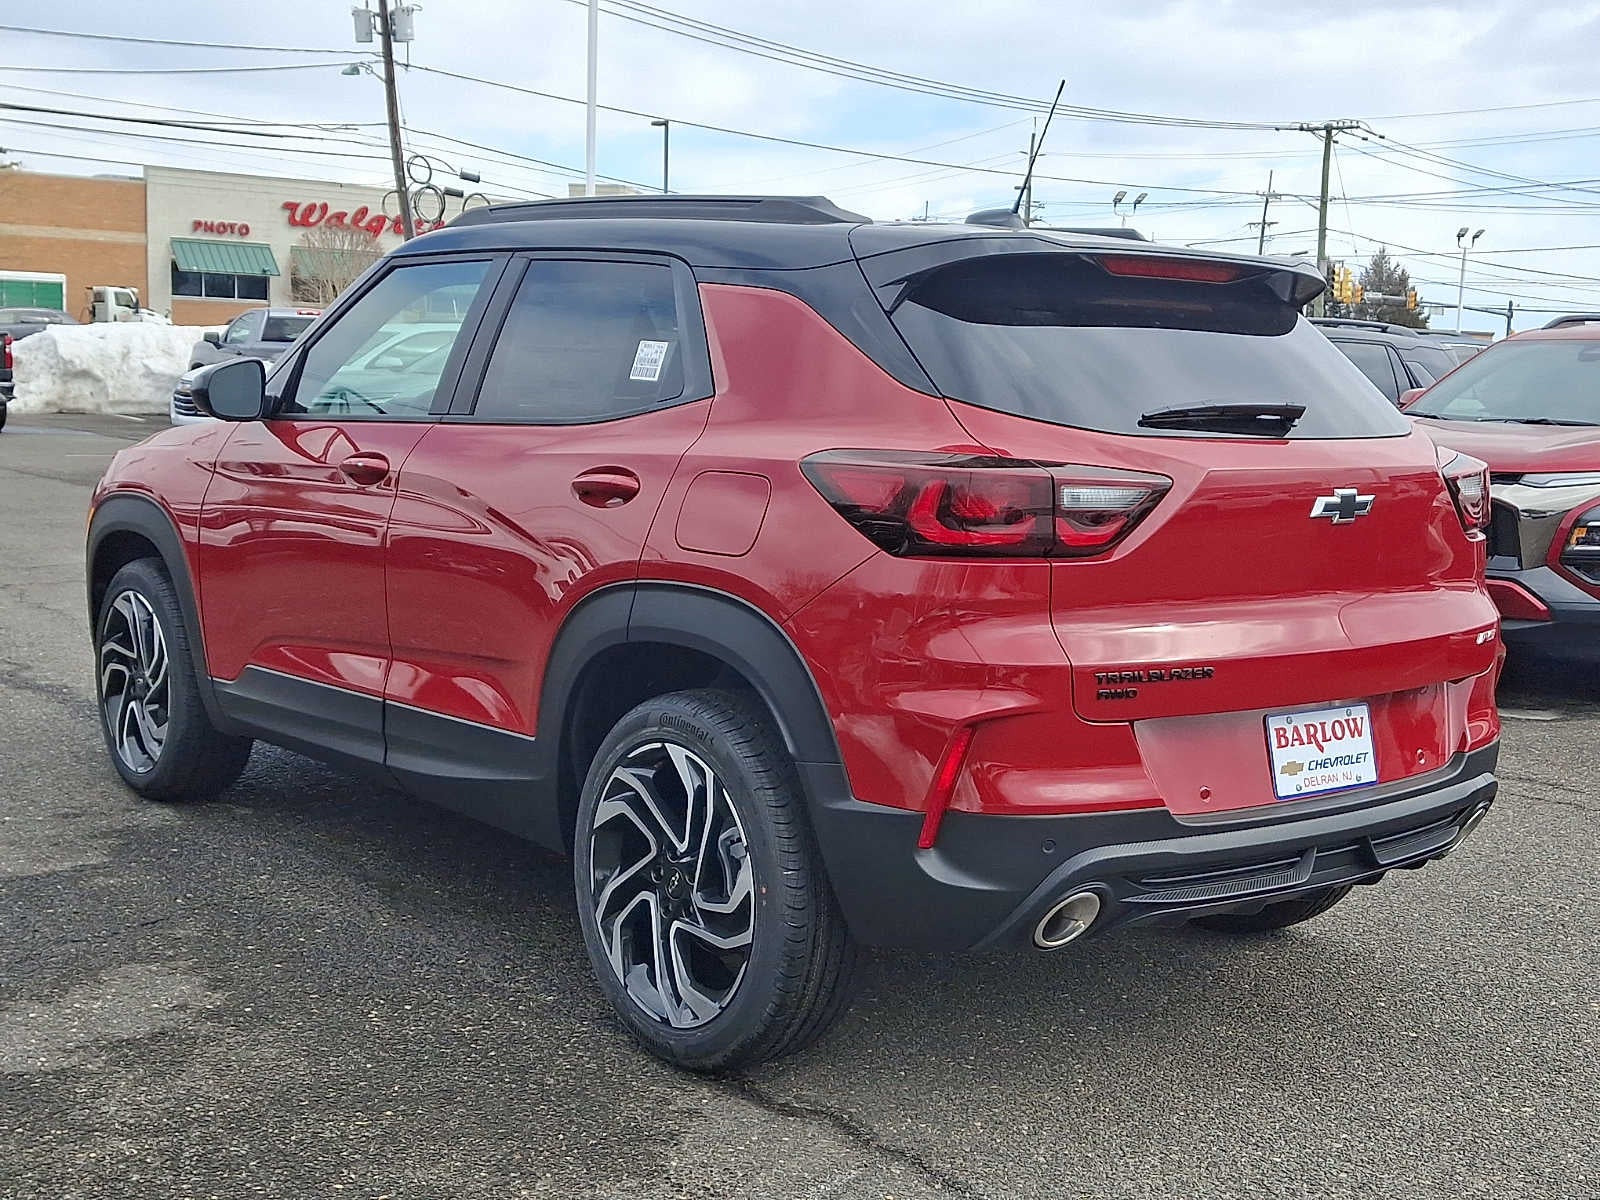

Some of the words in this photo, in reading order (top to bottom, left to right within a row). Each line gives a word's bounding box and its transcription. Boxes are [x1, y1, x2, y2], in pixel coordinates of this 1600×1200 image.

[191, 219, 250, 237] PHOTO
[281, 201, 446, 238] Walgre
[1095, 666, 1215, 685] TRAILBLAZER
[1096, 687, 1138, 700] AWD
[660, 712, 709, 742] Continental
[1273, 716, 1365, 753] BARLOW
[1307, 752, 1369, 771] CHEVROLET
[1303, 773, 1339, 788] DELRAN
[1342, 770, 1354, 782] NJ
